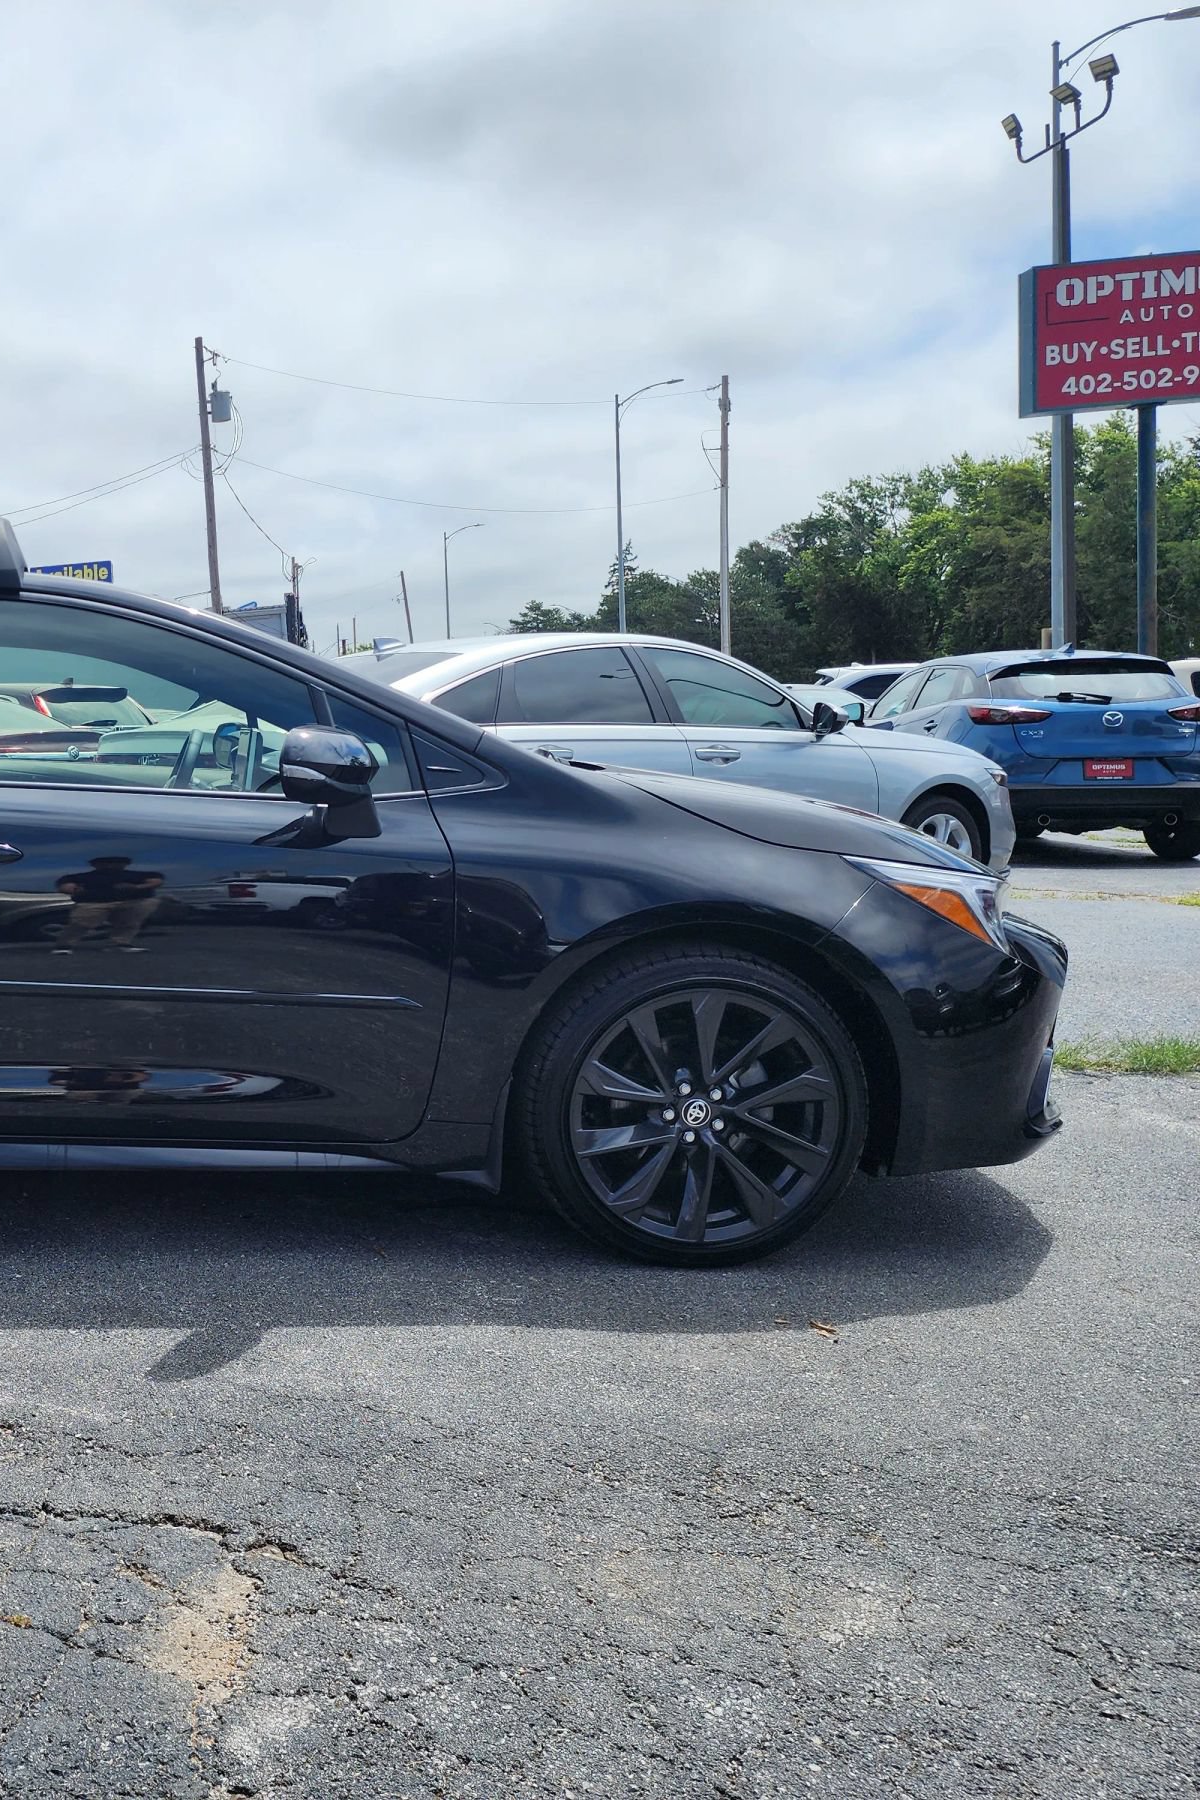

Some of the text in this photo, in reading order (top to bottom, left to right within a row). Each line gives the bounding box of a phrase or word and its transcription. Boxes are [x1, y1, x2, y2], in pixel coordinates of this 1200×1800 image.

[1056, 266, 1200, 307] OPTIM
[1119, 303, 1194, 324] AUTO
[1061, 365, 1200, 396] 402-502-9
